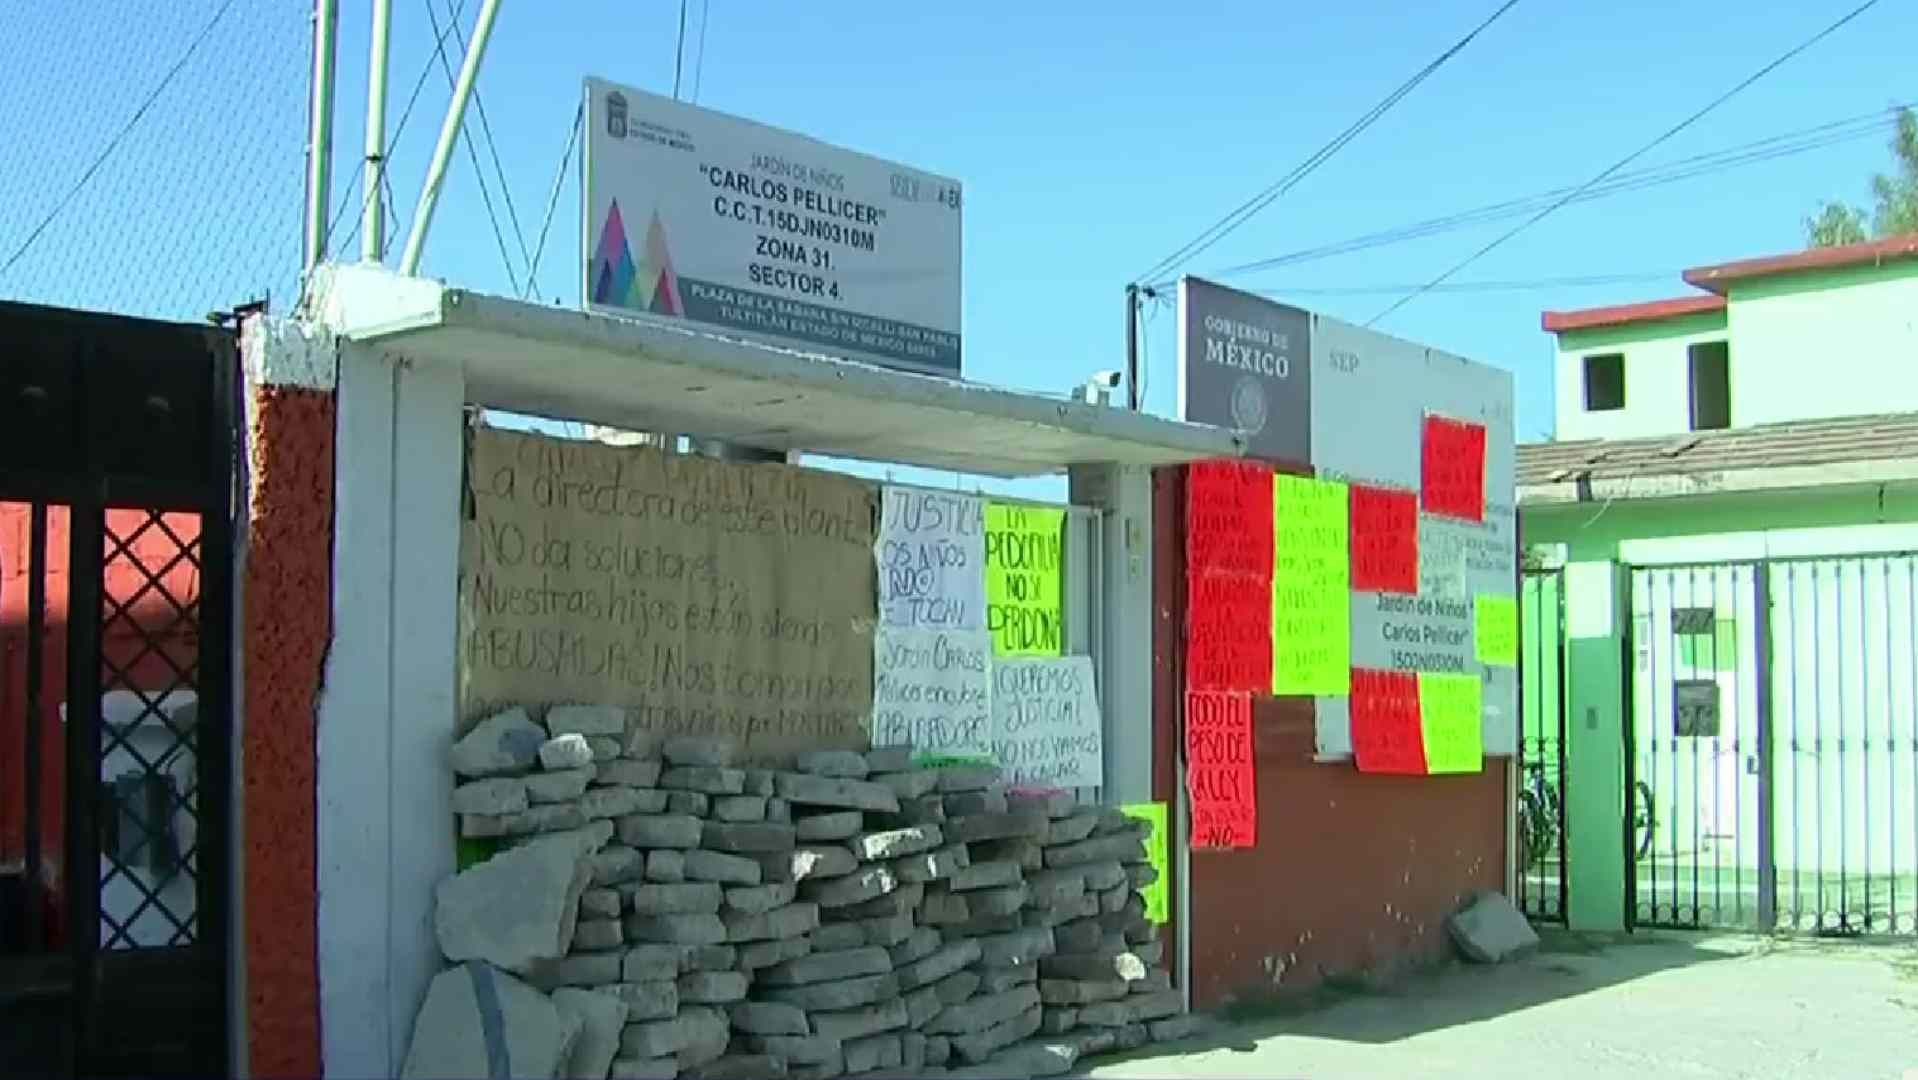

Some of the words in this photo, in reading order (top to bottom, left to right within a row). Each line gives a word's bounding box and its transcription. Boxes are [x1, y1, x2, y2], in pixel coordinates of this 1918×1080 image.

[699, 162, 788, 203] "CARLOS
[793, 186, 887, 226] PELLICER"
[756, 234, 808, 265] ZONA
[812, 247, 837, 271] 31.
[749, 262, 825, 298] SECTOR
[829, 280, 845, 301] 4.
[1205, 336, 1289, 379] MÉXICO
[478, 517, 525, 568] NO
[533, 533, 571, 572] da
[471, 573, 600, 621] Nuestras
[1005, 572, 1027, 603] NO
[1417, 598, 1433, 616] de
[1382, 621, 1421, 643] Carlos
